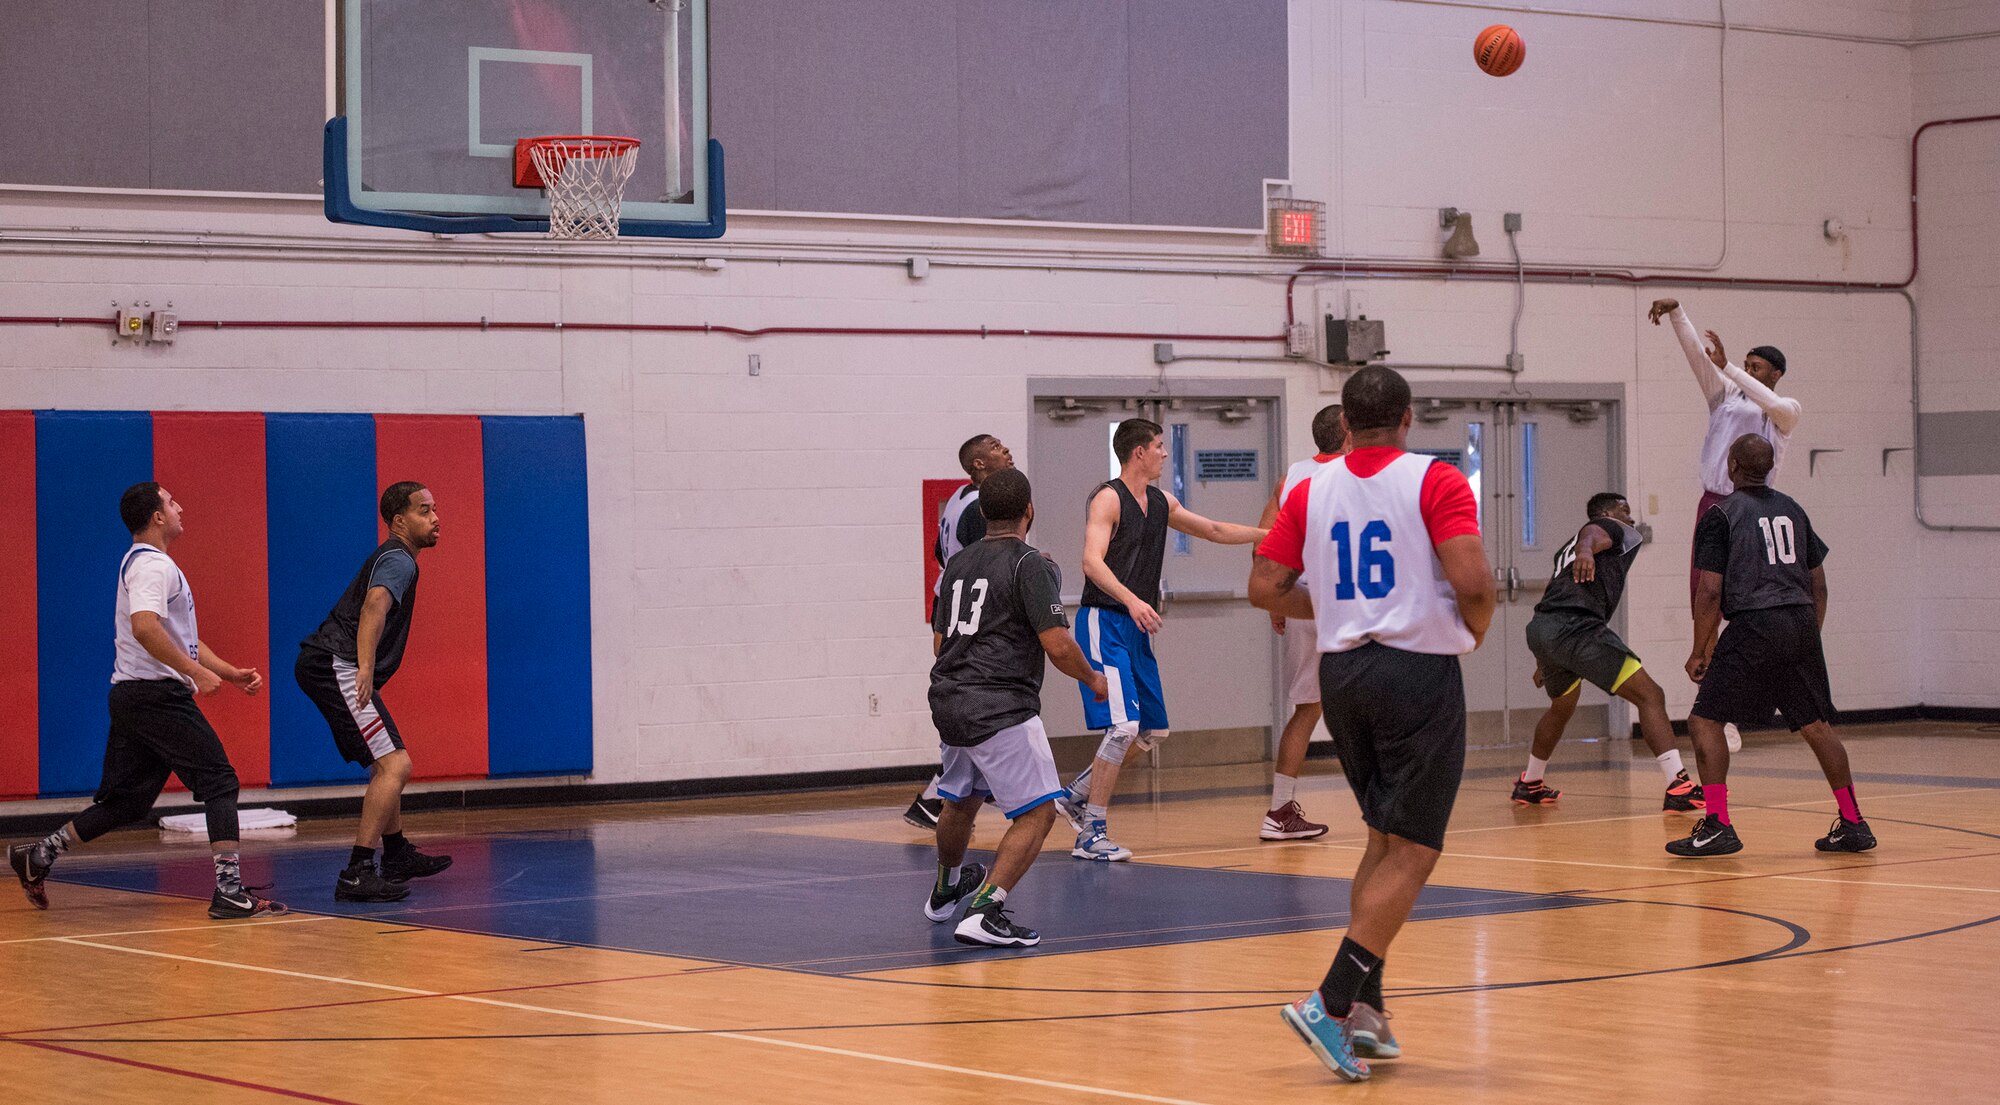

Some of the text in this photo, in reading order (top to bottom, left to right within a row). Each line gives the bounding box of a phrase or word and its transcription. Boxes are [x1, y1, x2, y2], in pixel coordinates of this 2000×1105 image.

[1480, 34, 1501, 65] Wilson
[1284, 213, 1312, 243] EXIT
[1331, 520, 1396, 600] 16
[1758, 515, 1797, 565] 10
[947, 578, 989, 638] 13
